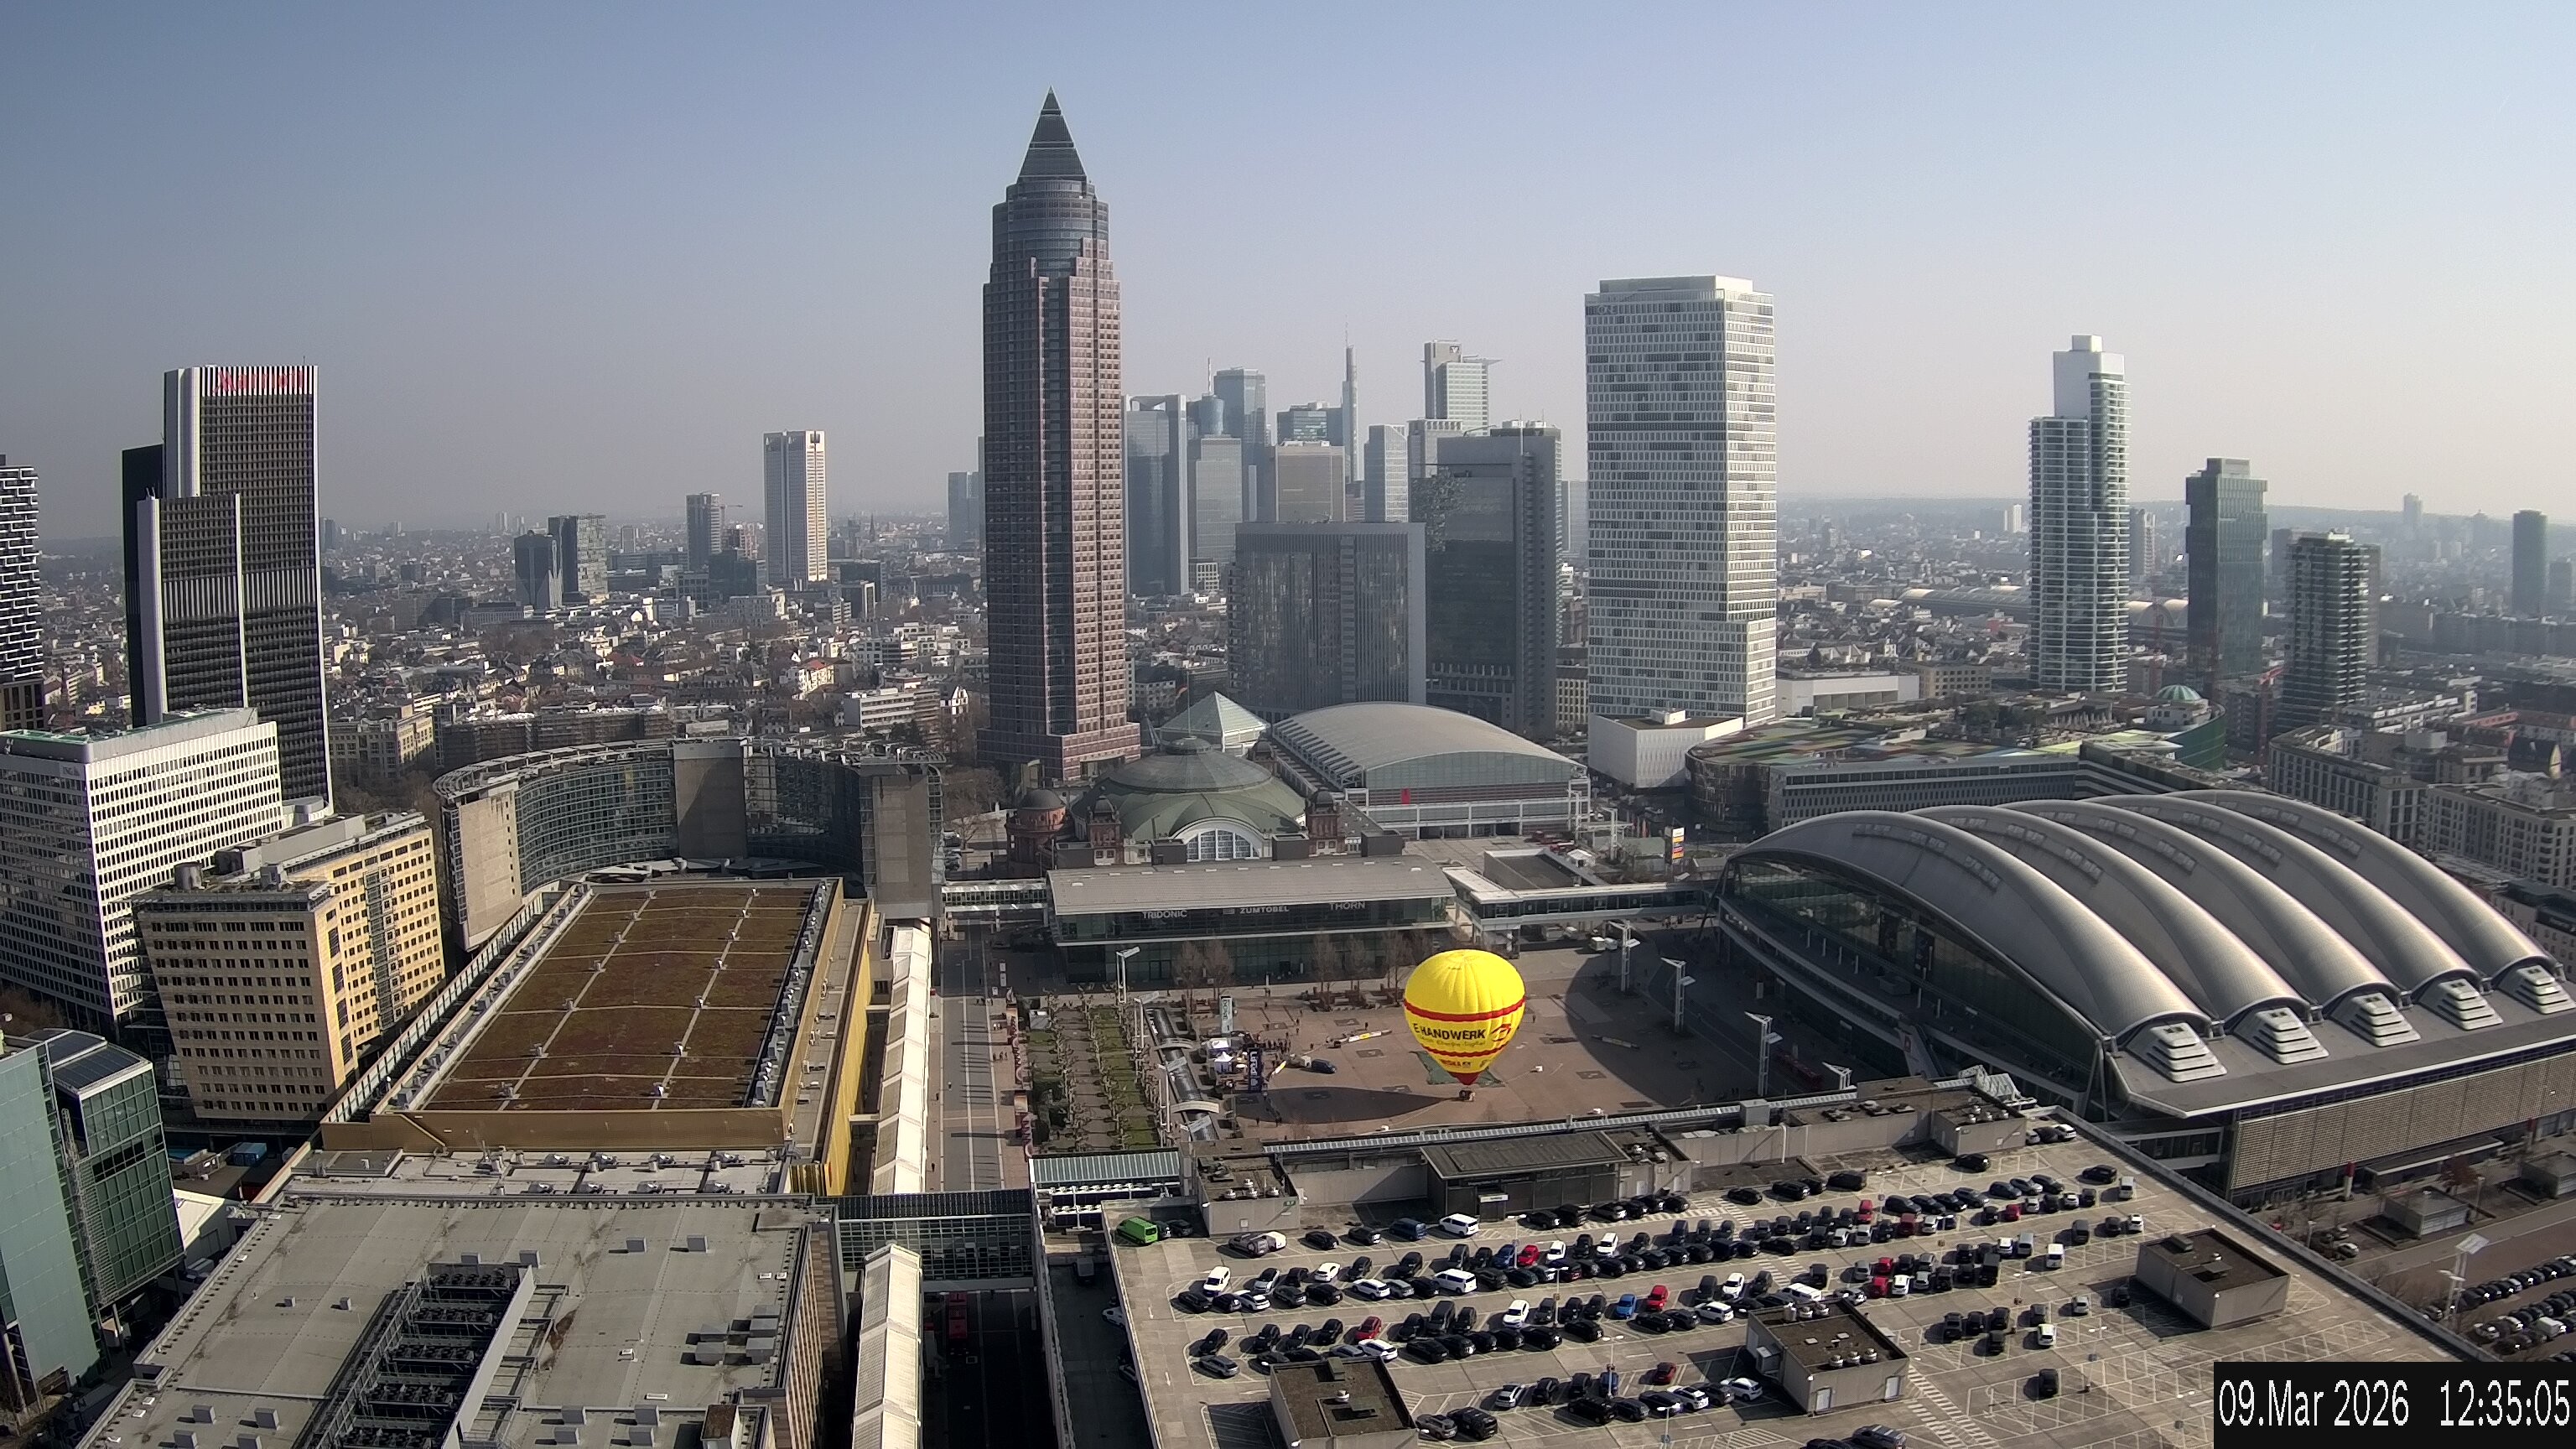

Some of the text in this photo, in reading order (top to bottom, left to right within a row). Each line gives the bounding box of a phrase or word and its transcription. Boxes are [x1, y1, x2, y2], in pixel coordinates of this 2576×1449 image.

[1239, 906, 1290, 915] ZUMTOBEL
[1329, 901, 1366, 911] THORN
[1142, 910, 1187, 919] TRIDONIC
[1420, 1026, 1486, 1040] HANDWERK
